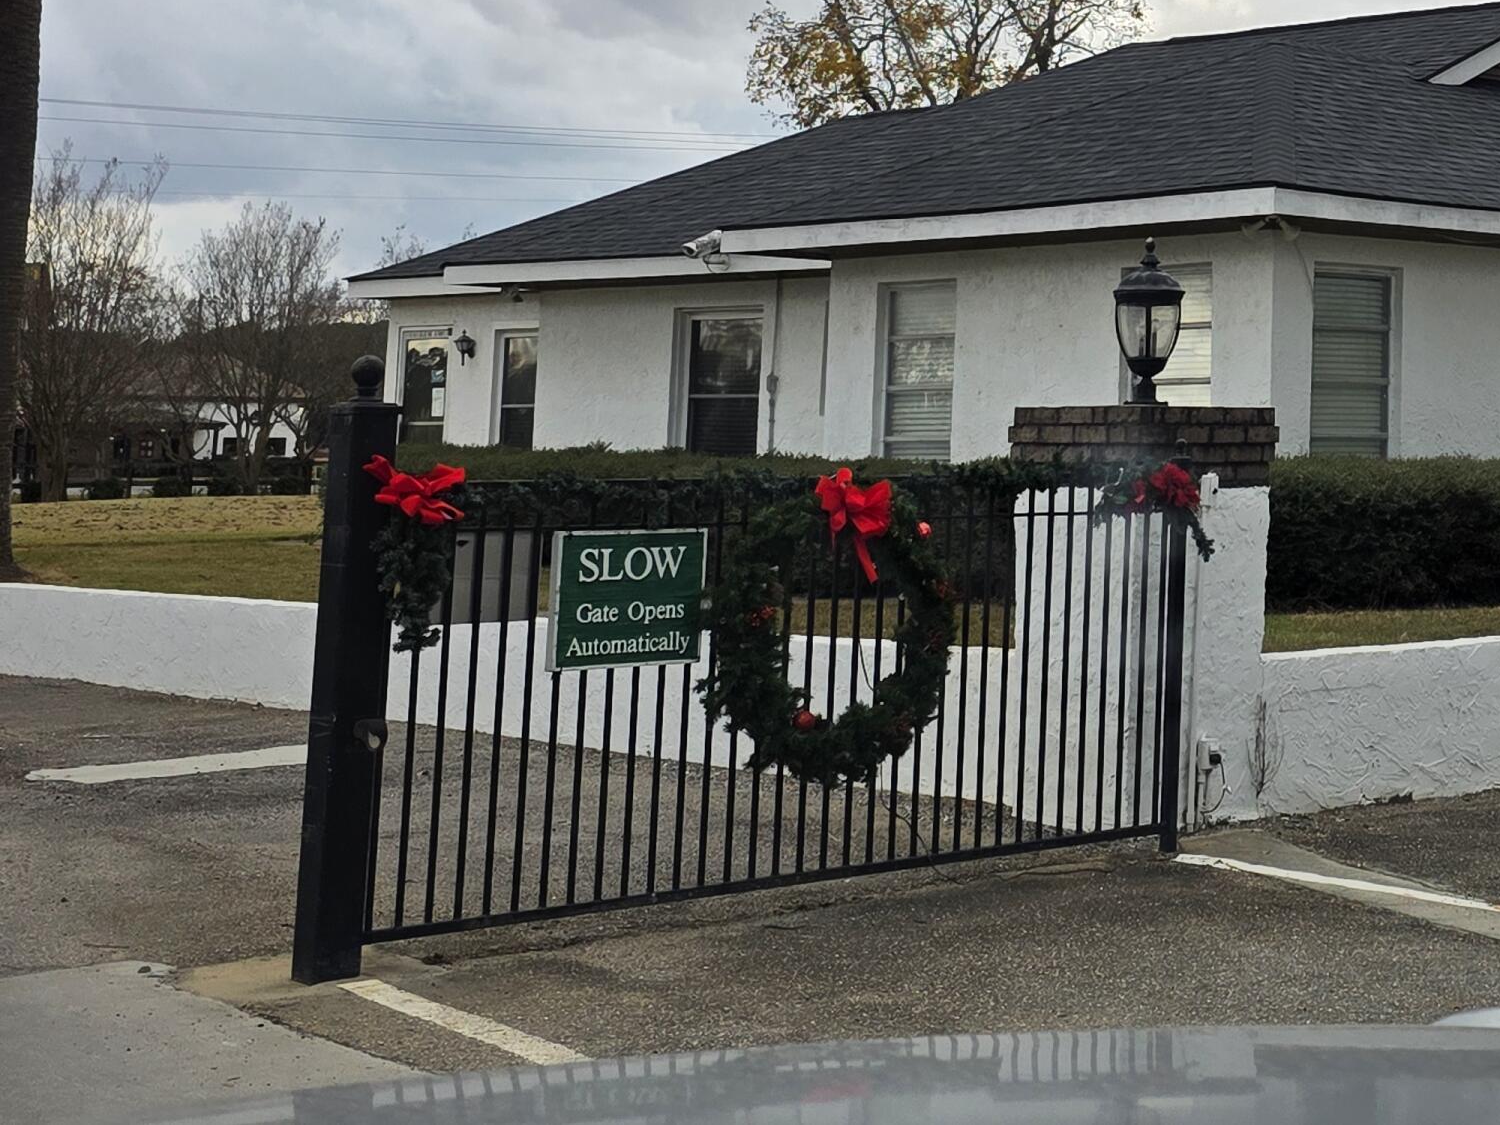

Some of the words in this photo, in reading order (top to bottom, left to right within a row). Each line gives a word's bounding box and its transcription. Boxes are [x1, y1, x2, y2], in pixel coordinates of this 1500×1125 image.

[579, 546, 687, 583] SLOW
[576, 603, 619, 623] Gate
[627, 601, 685, 624] Opens
[565, 631, 690, 657] Automatically
